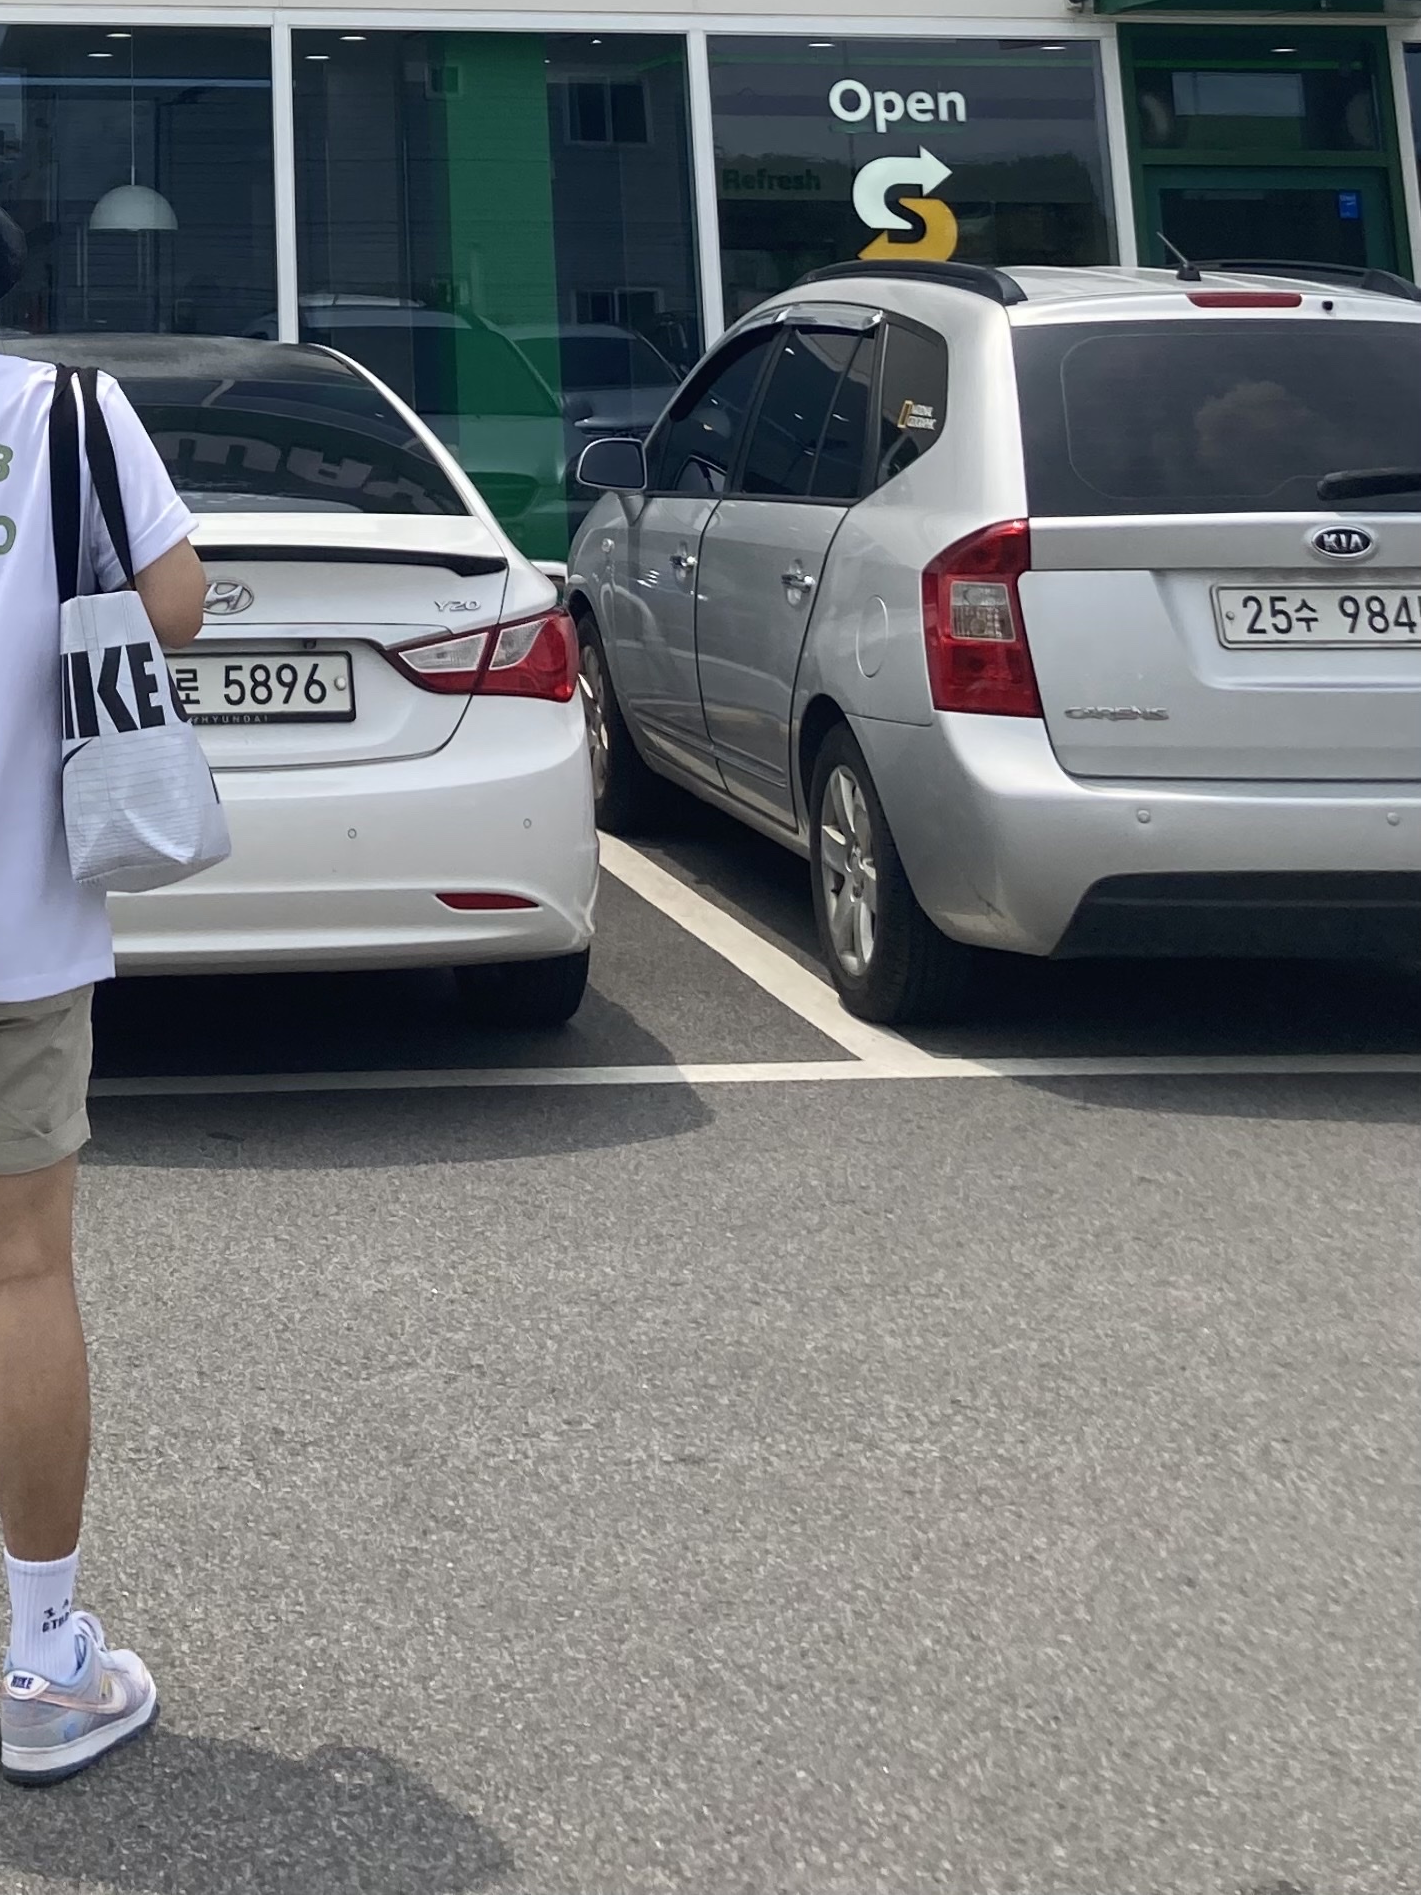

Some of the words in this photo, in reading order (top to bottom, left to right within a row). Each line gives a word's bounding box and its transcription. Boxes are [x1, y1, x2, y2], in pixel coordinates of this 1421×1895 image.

[829, 79, 967, 133] Open
[723, 169, 821, 191] Refresh
[1322, 533, 1367, 552] KIA
[434, 601, 481, 612] Y20
[1241, 595, 1319, 634] 25수
[1337, 595, 1421, 634] 984
[224, 663, 327, 706] 5896
[201, 715, 268, 723] HYUNDAI
[11, 1675, 34, 1689] NIKE
